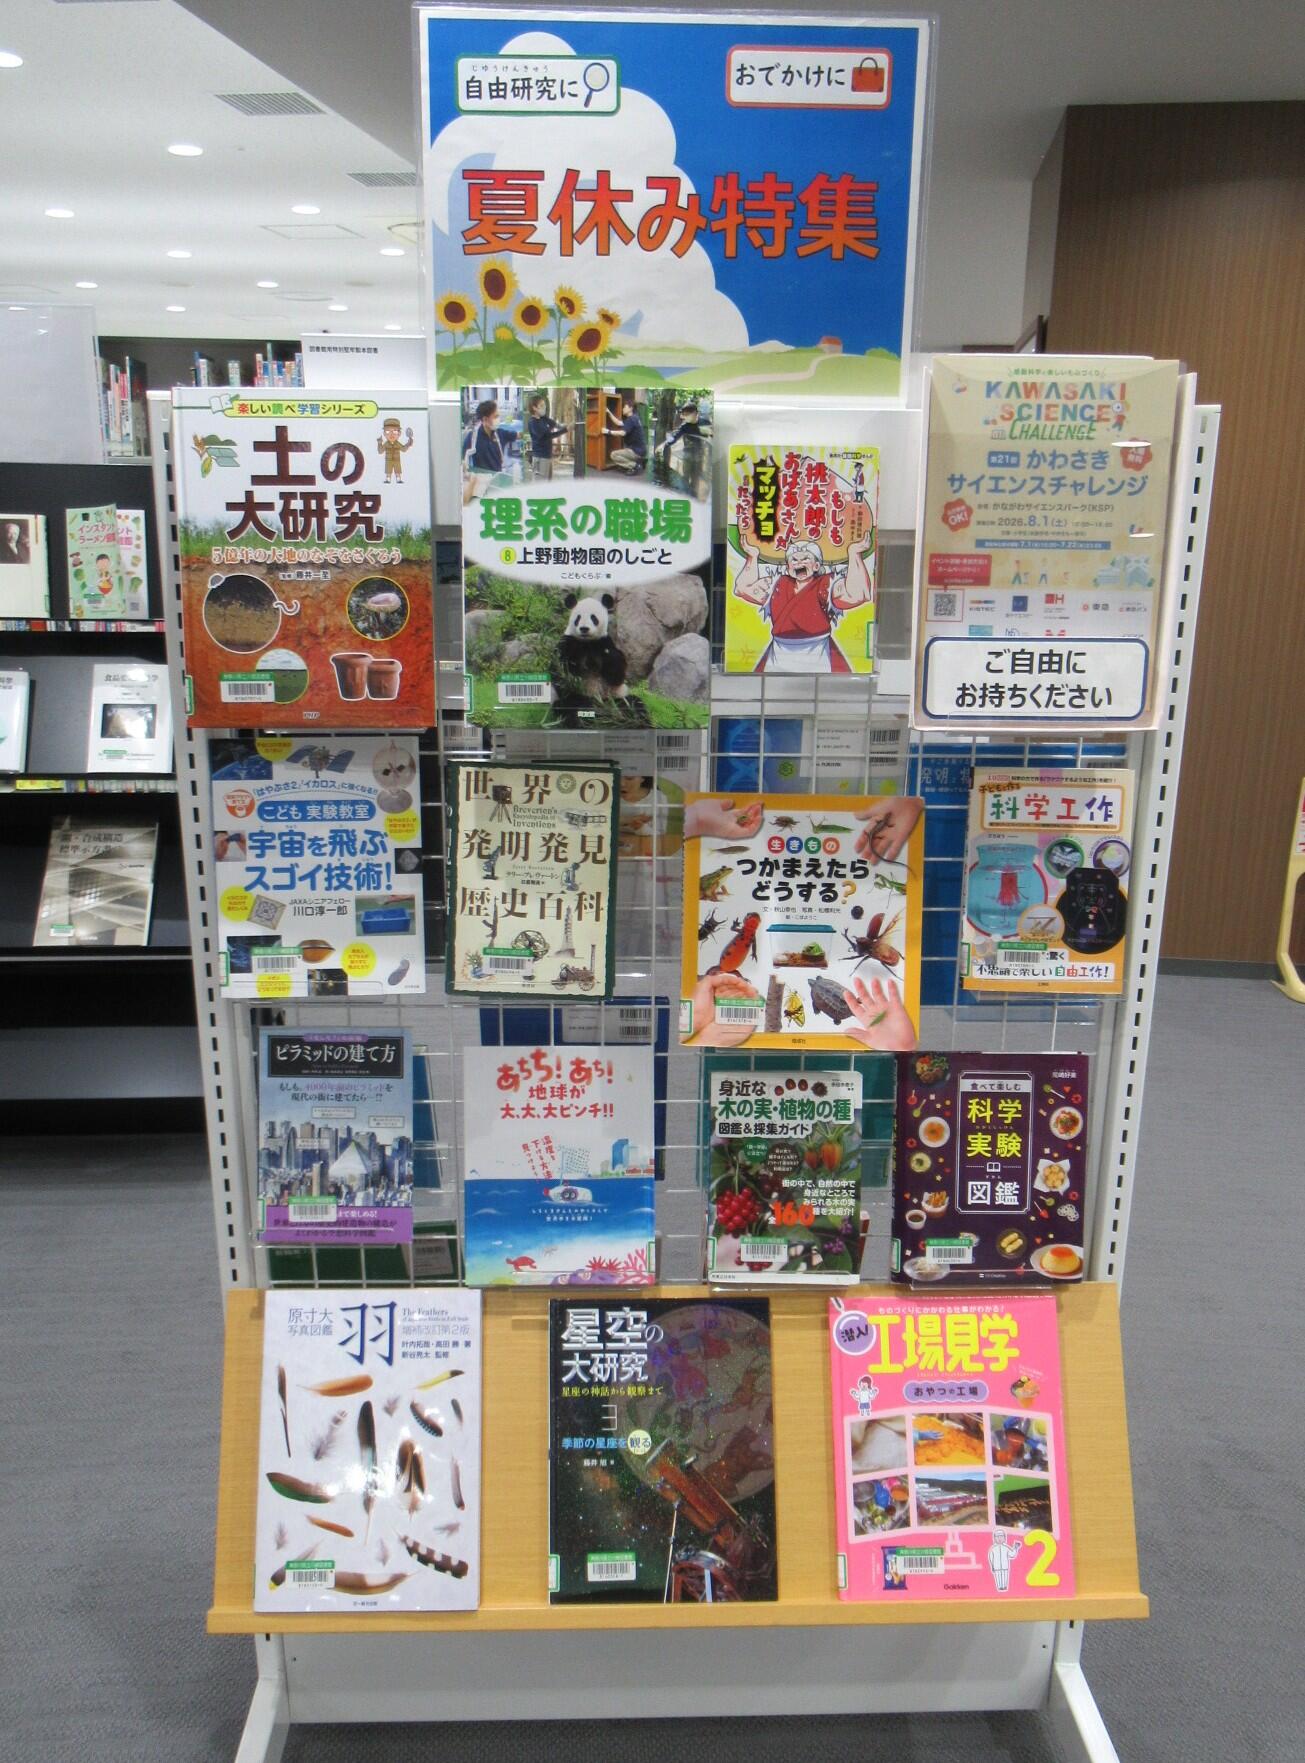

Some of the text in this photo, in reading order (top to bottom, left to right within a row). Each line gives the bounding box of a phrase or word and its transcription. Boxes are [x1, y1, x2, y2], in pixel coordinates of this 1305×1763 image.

[465, 75, 579, 101] 自由研究に
[735, 63, 846, 88] おでかけに
[461, 168, 881, 261] 夏休み特集
[985, 381, 1127, 400] KAWASAKI
[237, 403, 365, 414] 楽しい調べ学習シリーズ
[1000, 403, 1111, 422] SCIENCE
[1009, 418, 1098, 441] CHALLENGE
[251, 425, 366, 486] 土の
[1026, 449, 1110, 470] かわさき
[947, 474, 1148, 496] サイエンスチャレンジ
[755, 466, 777, 536] マッチョ
[804, 462, 828, 539] 桃太郎の
[225, 490, 384, 542] 大研究
[479, 497, 694, 544] 理系の職場
[830, 490, 845, 546] もしも
[211, 547, 402, 565] 5億年の大地のなぞをさぐろう
[503, 547, 673, 566] 8 上野動物園のしごと
[985, 648, 1087, 675] ご自由に
[955, 682, 1113, 710] お持ちください
[463, 770, 610, 806] 世界の
[263, 804, 370, 820] こども 実験教室
[989, 793, 1114, 822] 科学工作
[247, 829, 388, 859] 宇宙を飛ぶ
[463, 829, 608, 865] 発明発見
[768, 837, 839, 853] 生きもの
[244, 862, 392, 892] スゴイ技術!
[736, 858, 870, 880] つかまえたら
[460, 886, 605, 923] 歴史百科
[751, 880, 858, 905] どうする?
[293, 905, 348, 917] 川口淳一郎
[276, 1043, 397, 1063] ピラミッドの建て方
[496, 1047, 615, 1092] あちち! あち!
[528, 1083, 586, 1100] 地球が
[718, 1079, 767, 1097] 身近な
[970, 1082, 1022, 1091] 食べて楽しむ
[500, 1102, 615, 1120] 大、大、大ピンチ!!
[718, 1098, 852, 1122] 木の実・植物の種
[967, 1097, 1023, 1125] 科学
[718, 1122, 810, 1136] 図鑑&採集ガイド
[966, 1132, 1023, 1158] 実験
[967, 1181, 1021, 1206] 図鑑
[287, 1308, 334, 1325] 原寸大
[561, 1306, 664, 1351] 星空の
[287, 1325, 334, 1337] 写真図鑑
[338, 1301, 399, 1367] 羽
[841, 1324, 869, 1343] 潜入
[867, 1314, 1020, 1374] 工場見学
[561, 1353, 649, 1383] 大研究
[561, 1386, 664, 1398] 星座の神話から観察まで
[913, 1385, 979, 1397] おやつの工場
[1023, 1528, 1061, 1587] 2
